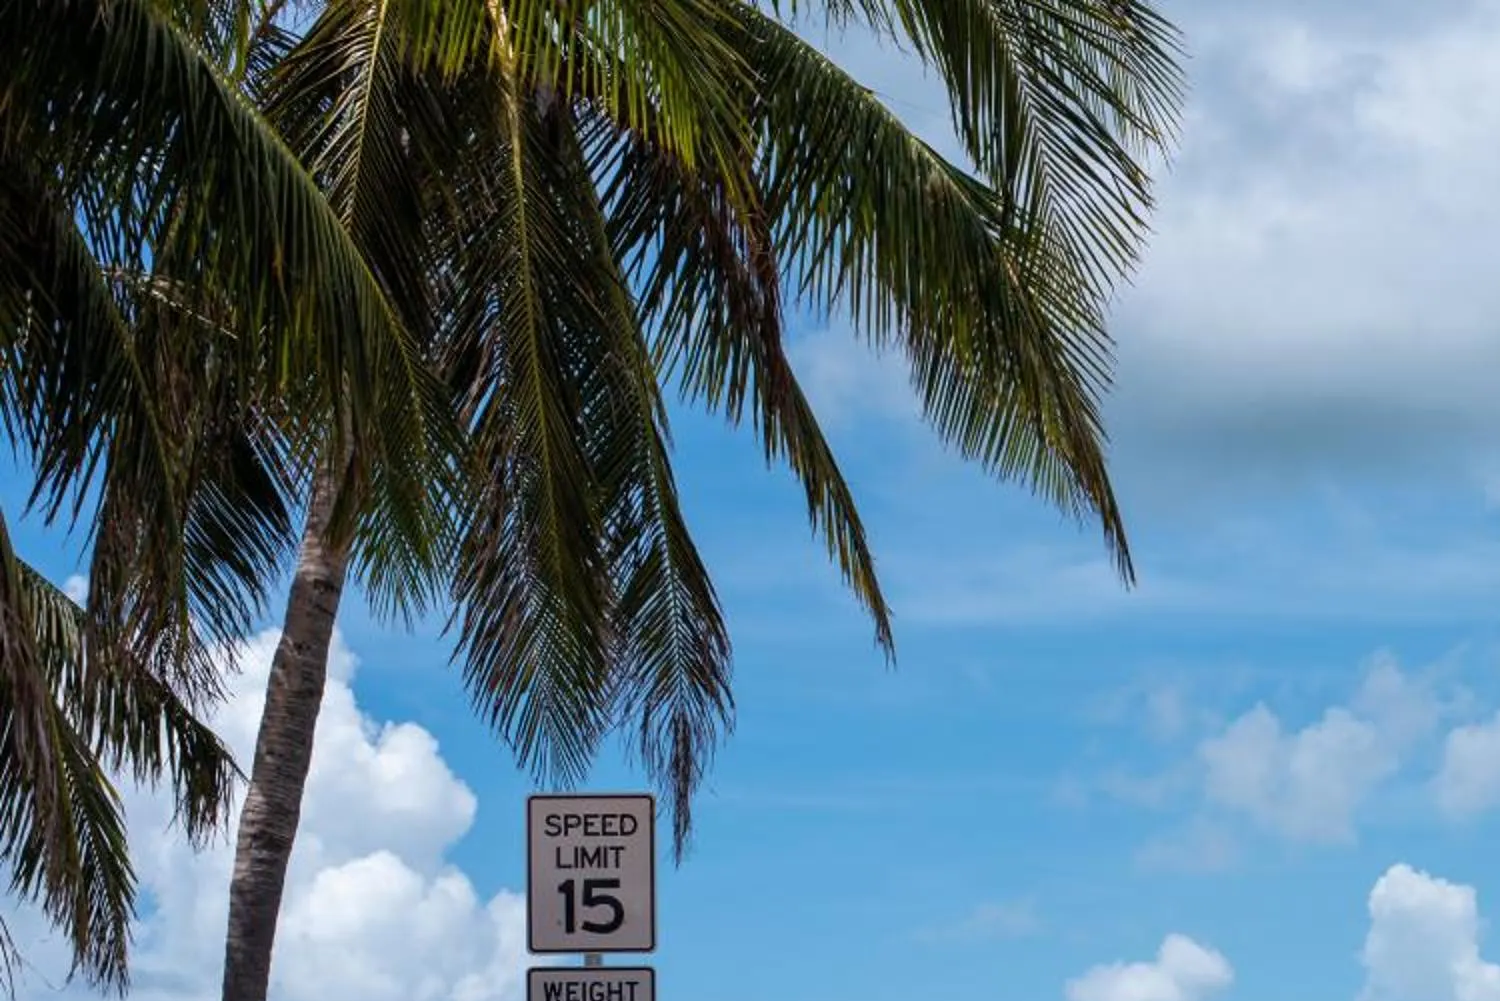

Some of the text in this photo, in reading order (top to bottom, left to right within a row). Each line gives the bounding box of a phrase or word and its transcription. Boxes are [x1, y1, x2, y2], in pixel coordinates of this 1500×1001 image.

[545, 813, 638, 837] SPEED
[556, 846, 625, 869] LIMIT
[557, 878, 625, 934] 15
